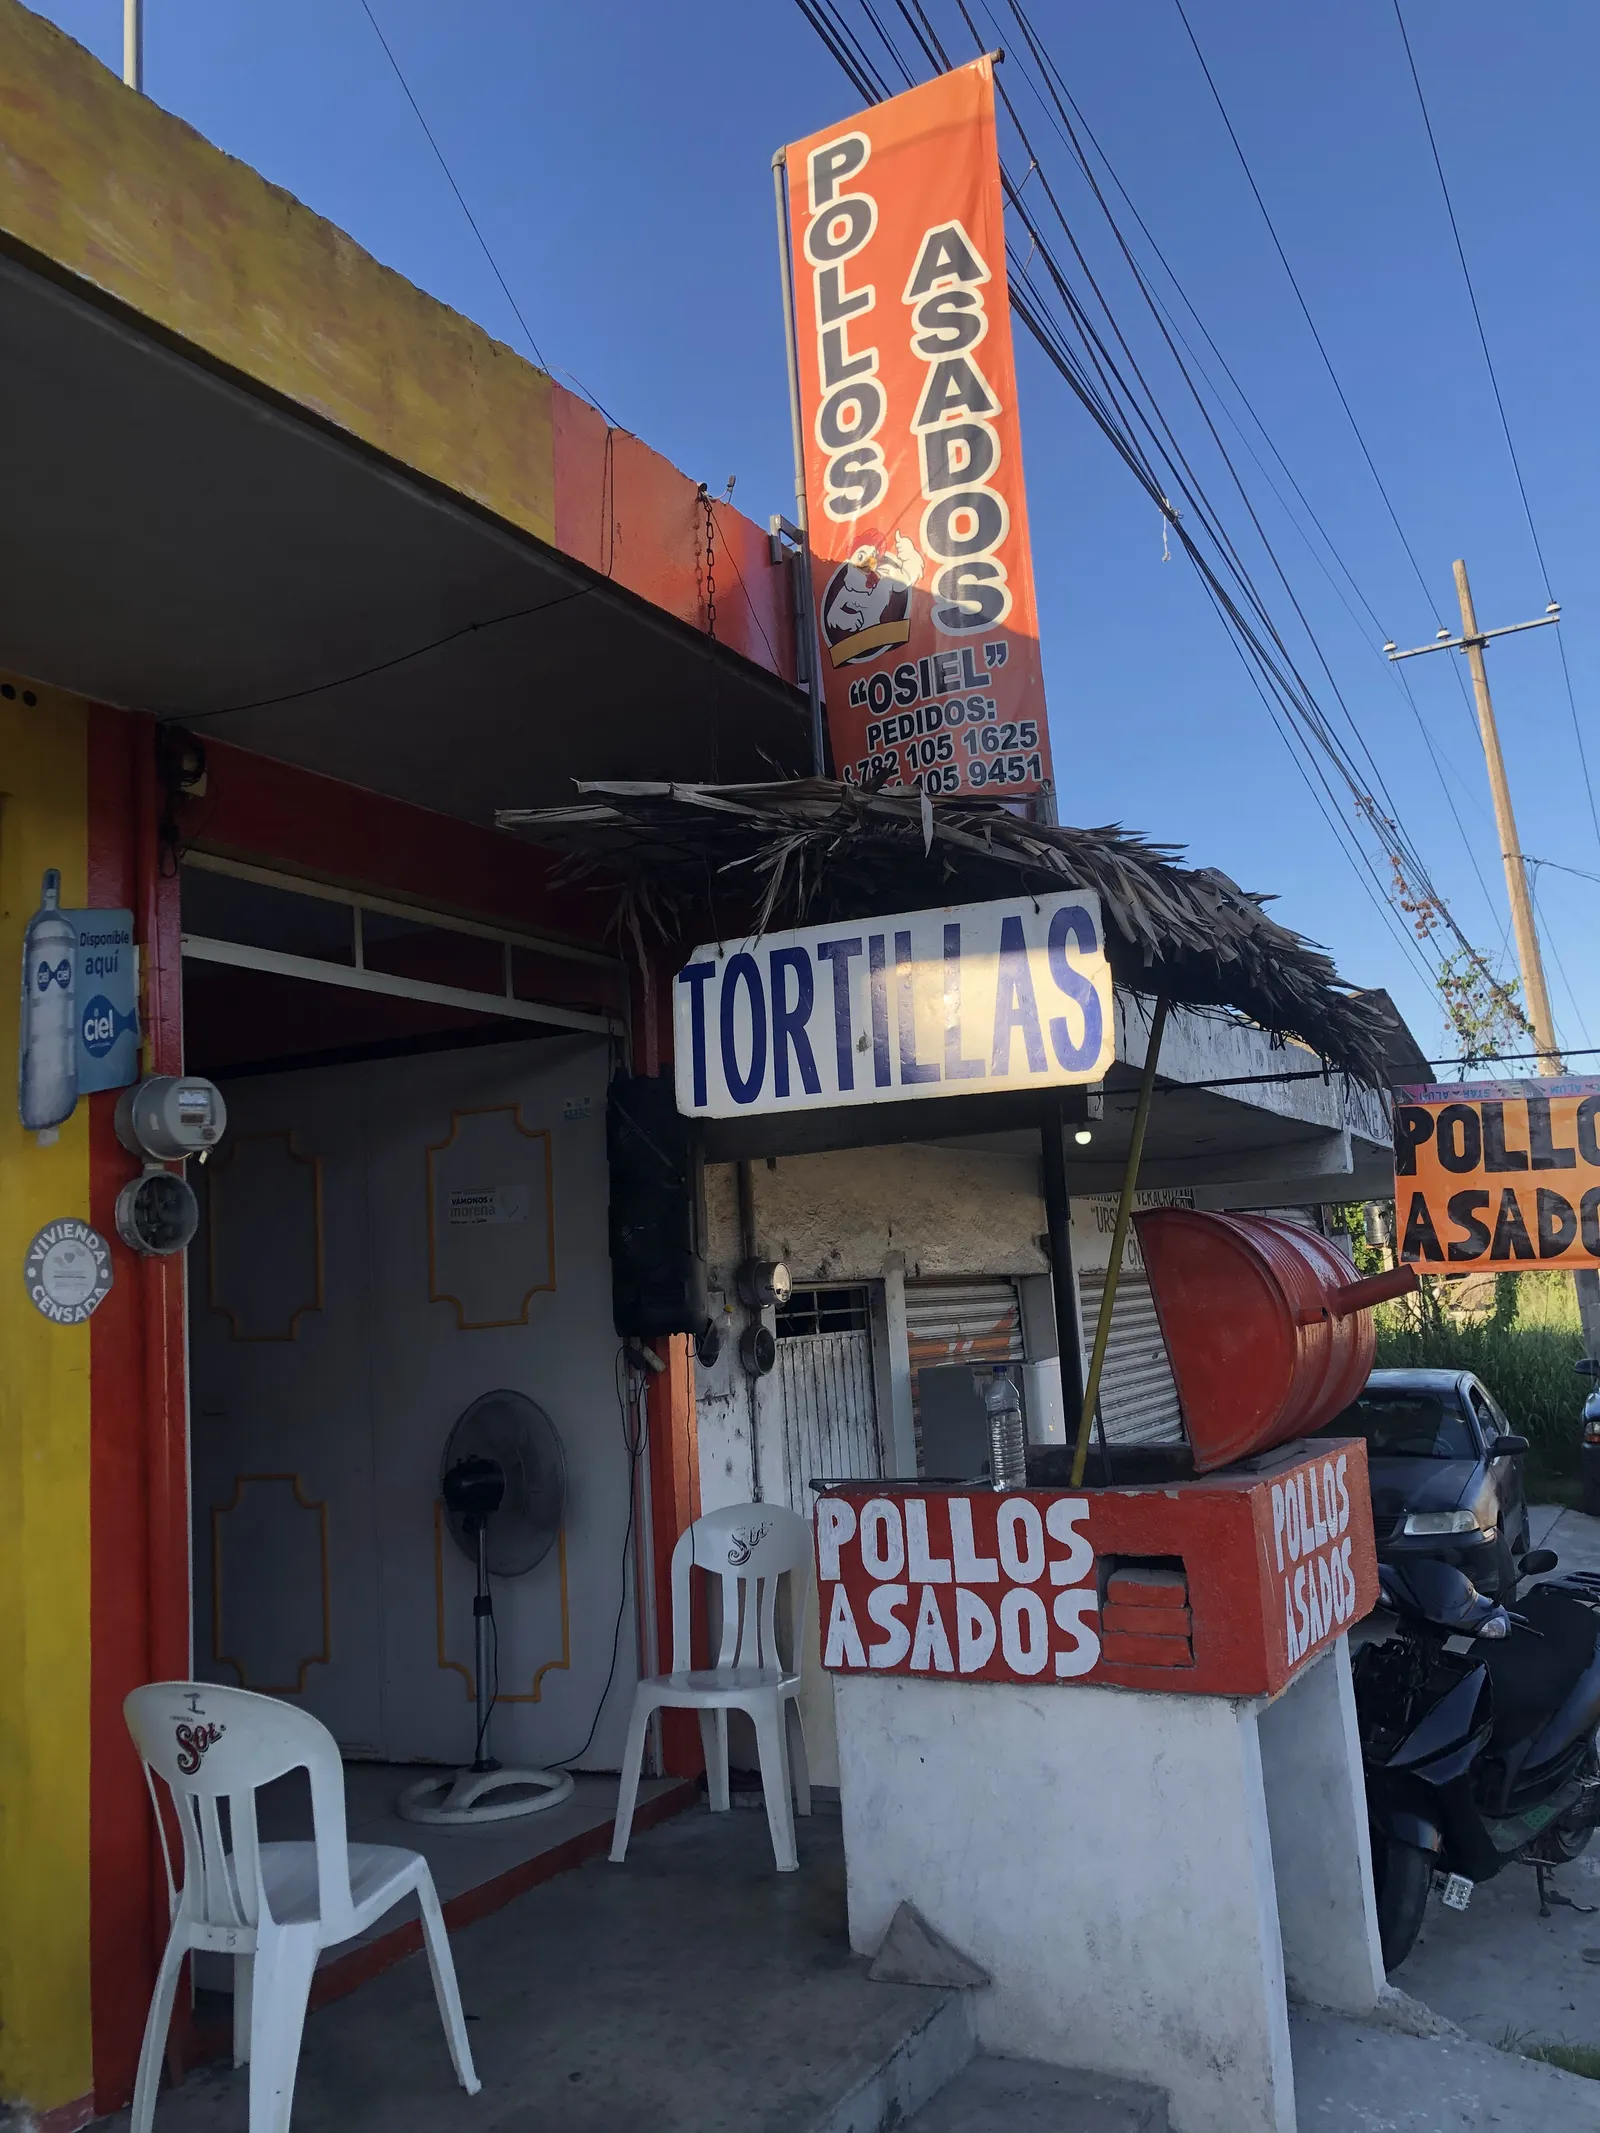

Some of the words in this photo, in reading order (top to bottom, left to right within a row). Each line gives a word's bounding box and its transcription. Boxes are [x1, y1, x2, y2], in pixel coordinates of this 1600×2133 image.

[804, 132, 888, 522] POLLOS
[902, 220, 1012, 636] ASADOS
[866, 696, 997, 752] PEDIDOS:
[906, 733, 954, 771] 105
[963, 721, 1038, 755] 1625
[967, 752, 1043, 787] 9451
[80, 930, 129, 948] Disponible
[85, 949, 118, 979] aquí
[84, 1008, 114, 1041] ciel
[679, 905, 1103, 1107] TORTILLAS
[31, 1223, 107, 1265] VIVIENDA
[817, 1496, 1094, 1586] POLLOS
[1271, 1453, 1350, 1573] POLLOS
[824, 1583, 1100, 1678] ASADOS
[1284, 1536, 1356, 1667] ASADOS
